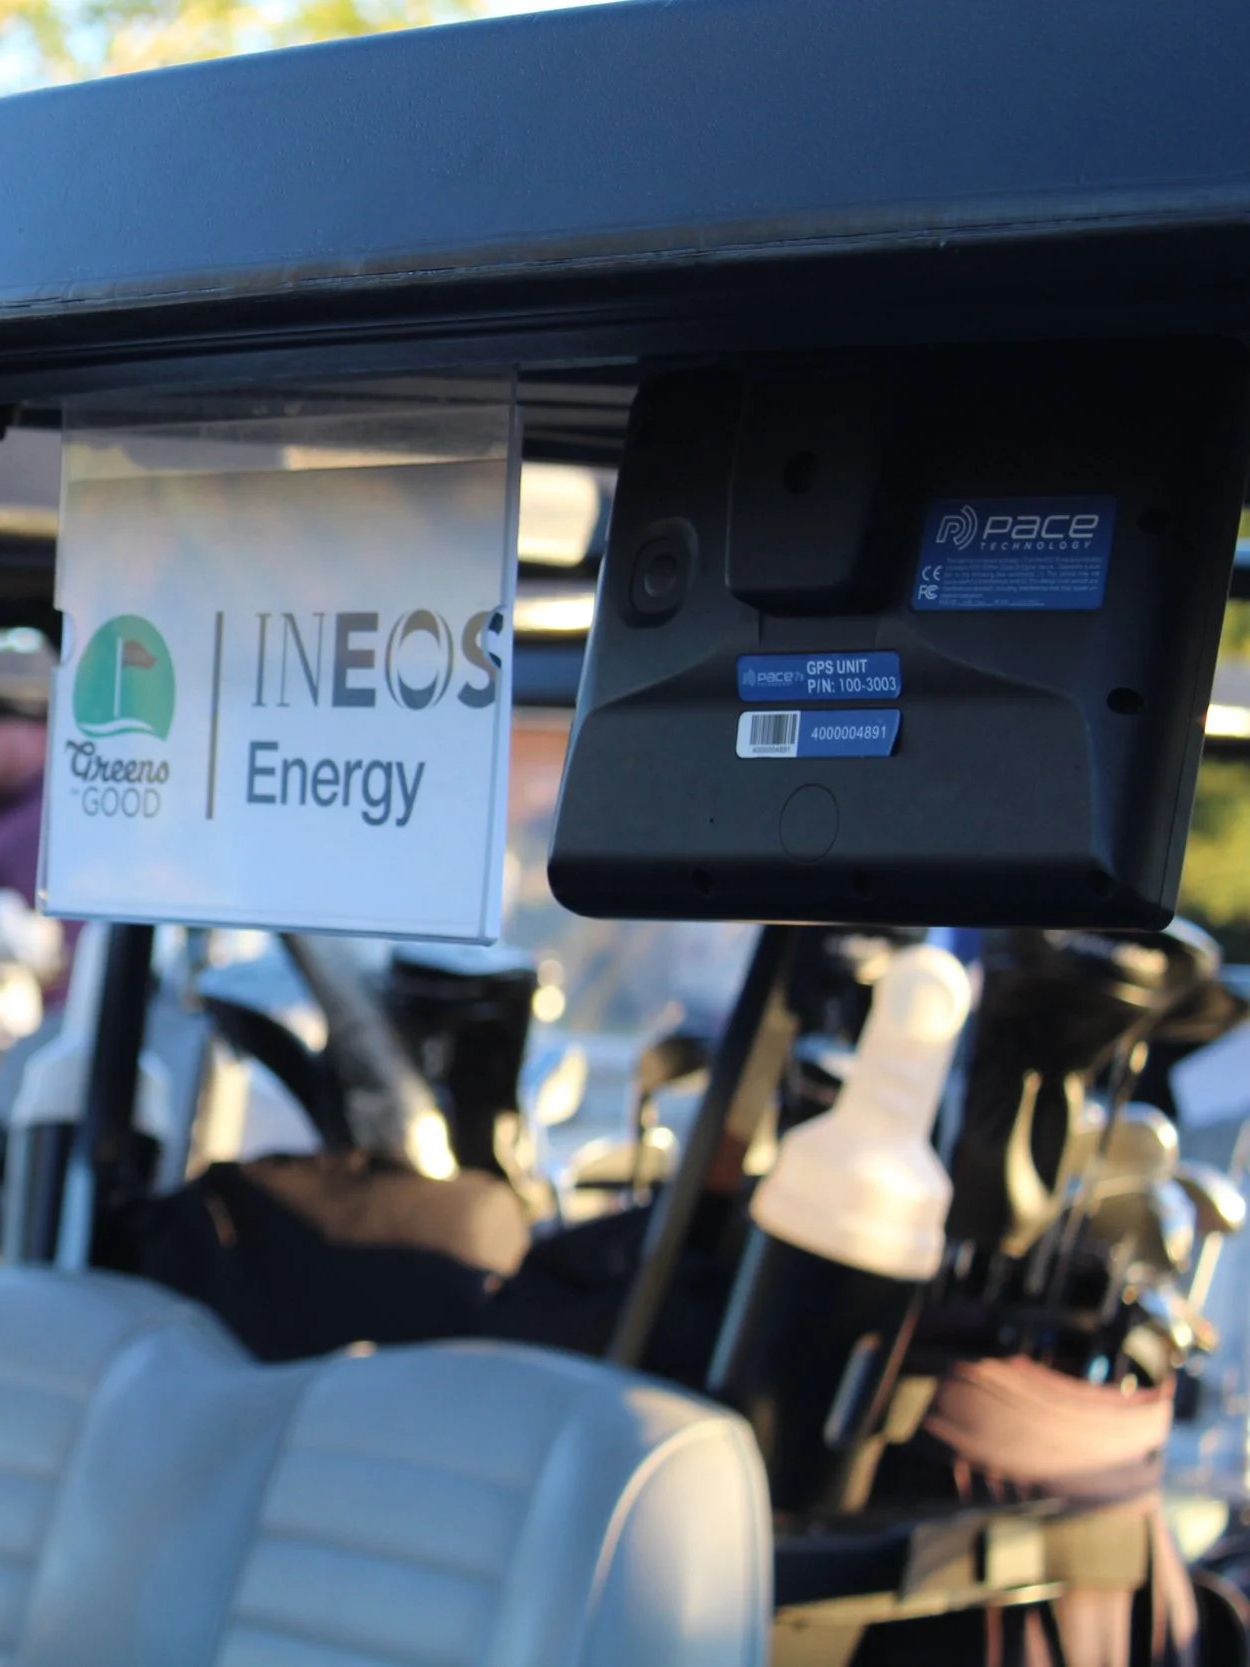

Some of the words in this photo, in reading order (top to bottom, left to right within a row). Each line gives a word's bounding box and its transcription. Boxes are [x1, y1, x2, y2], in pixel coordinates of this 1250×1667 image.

[980, 541, 1091, 551] TECHNOLOGY
[251, 609, 504, 711] INEOS
[806, 661, 834, 675] GPS
[836, 659, 868, 674] UNIT
[808, 679, 836, 693] P/N:
[839, 677, 897, 692] 100-3003
[811, 726, 887, 740] 4000004891
[65, 740, 170, 784] Greens
[246, 741, 426, 826] Energy
[82, 786, 162, 818] GOOD
